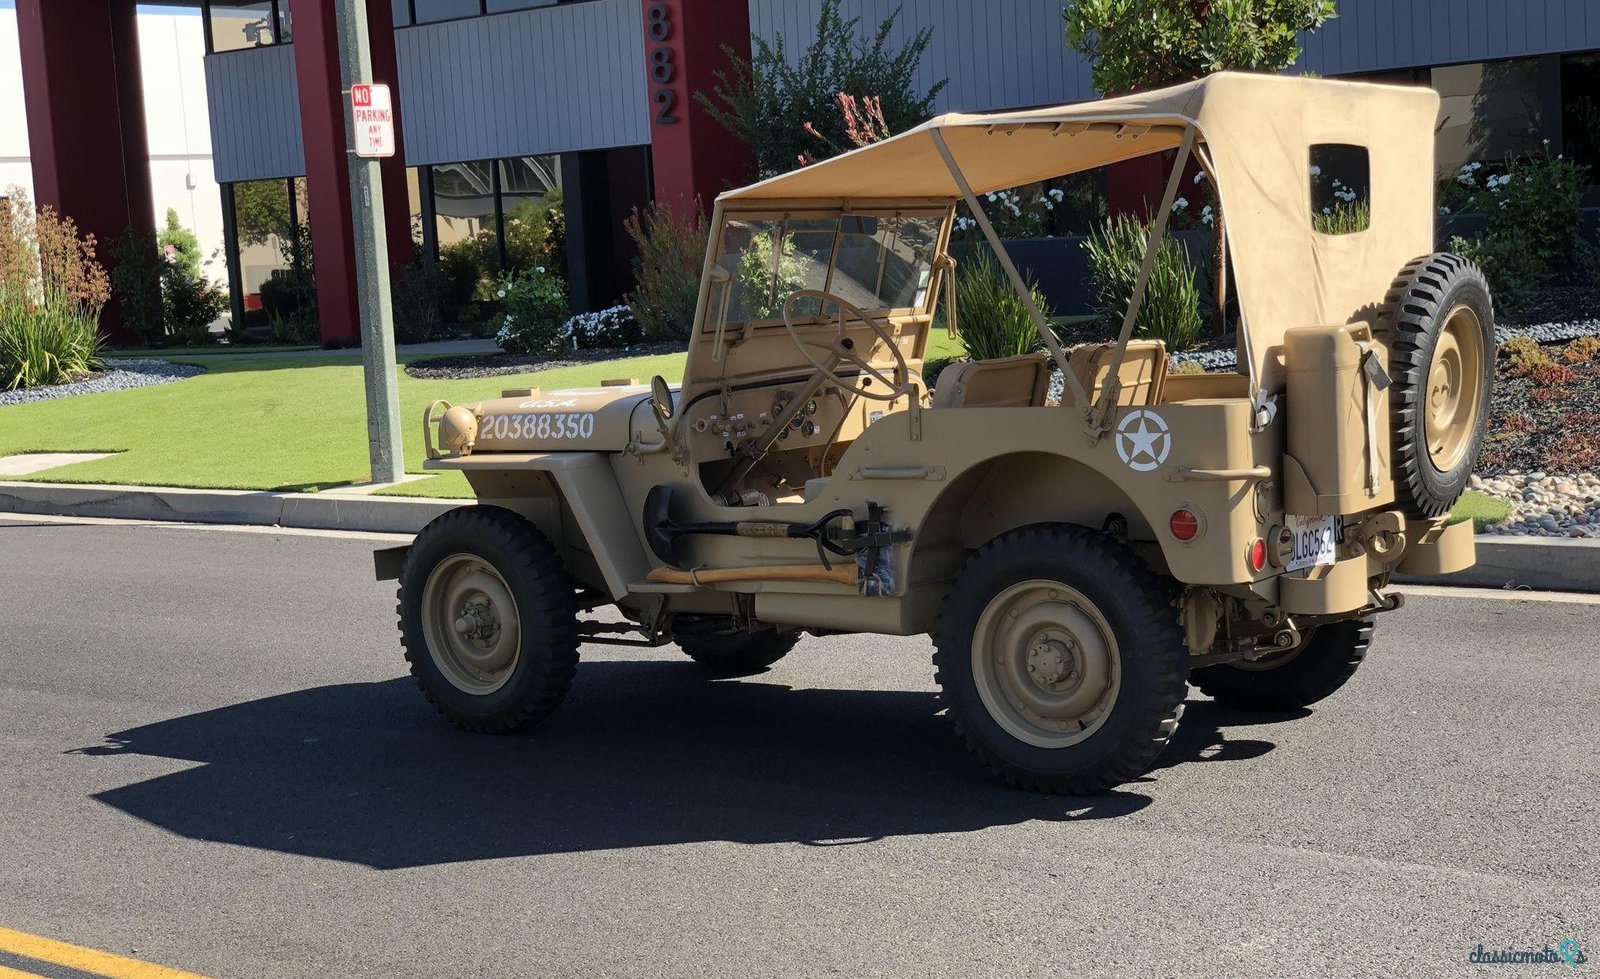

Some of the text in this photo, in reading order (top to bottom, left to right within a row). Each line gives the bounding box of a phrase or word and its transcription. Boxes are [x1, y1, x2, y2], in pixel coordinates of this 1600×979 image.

[354, 88, 369, 104] NO
[356, 109, 391, 122] PARKING
[368, 125, 382, 135] ANY
[369, 137, 383, 147] TIME
[480, 413, 594, 439] 20388350
[1291, 527, 1332, 560] LGC562
